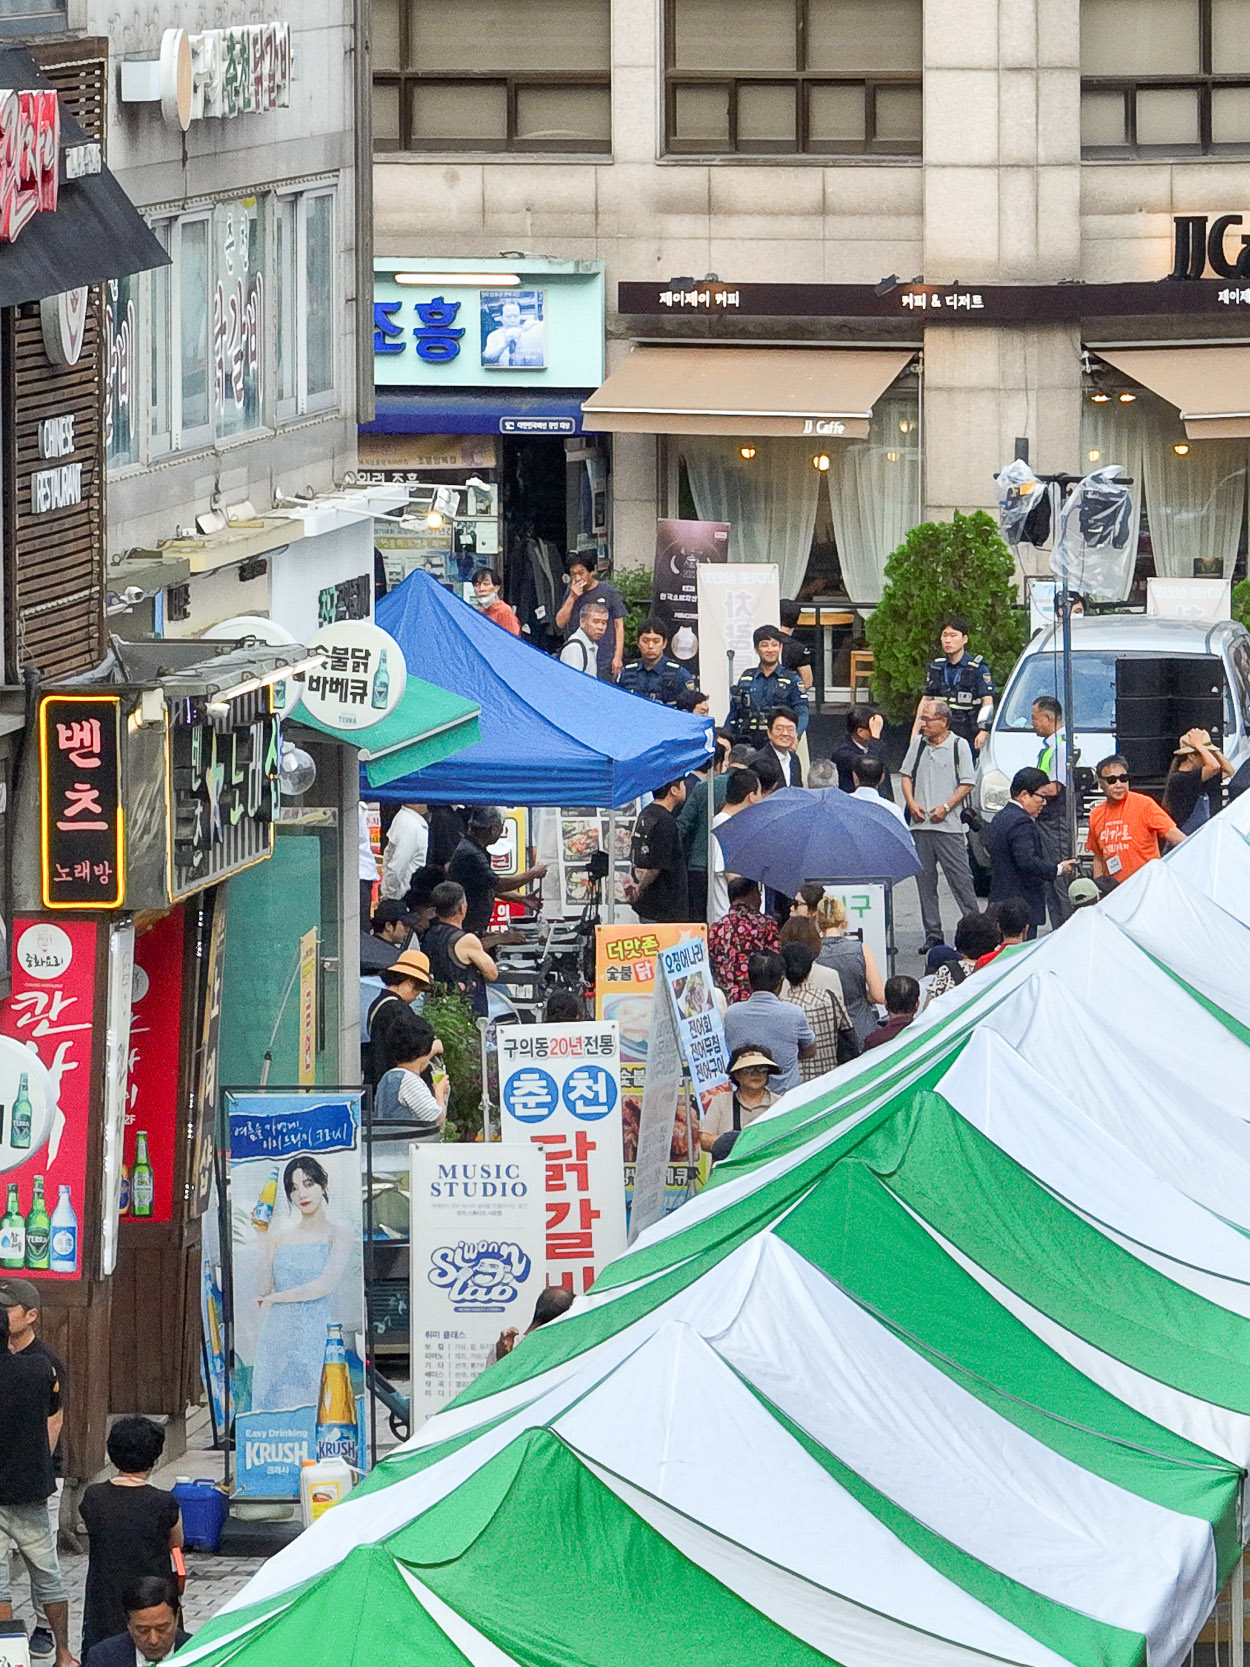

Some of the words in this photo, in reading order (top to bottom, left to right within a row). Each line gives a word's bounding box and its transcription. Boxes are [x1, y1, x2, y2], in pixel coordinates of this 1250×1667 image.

[714, 290, 740, 308] 커피
[901, 293, 926, 308] 커피
[930, 295, 942, 308] &
[944, 294, 985, 310] 디저트
[42, 413, 76, 459] CHINESE
[803, 419, 814, 434] JJ
[815, 419, 846, 435] Caffe
[36, 462, 83, 514] RESTAURANT
[307, 675, 369, 706] 바베큐
[56, 717, 109, 832] 벤츠
[53, 859, 113, 886] 노래방
[25, 952, 64, 968] 중화요리
[606, 934, 659, 961] 더맛존
[665, 943, 705, 974] 오징어나라
[688, 1015, 713, 1040] 전어회
[691, 1035, 723, 1062] 전어무침
[509, 1070, 610, 1118] 춘천
[437, 1163, 521, 1180] MUSIC
[430, 1181, 528, 1198] STUDIO
[530, 1131, 600, 1297] 닭갈비
[424, 1330, 440, 1340] 취미
[443, 1330, 467, 1340] 클래스
[245, 1429, 267, 1439] Easy
[268, 1429, 309, 1439] Drinking
[245, 1440, 309, 1471] KRUSH
[317, 1440, 356, 1459] KRUSH
